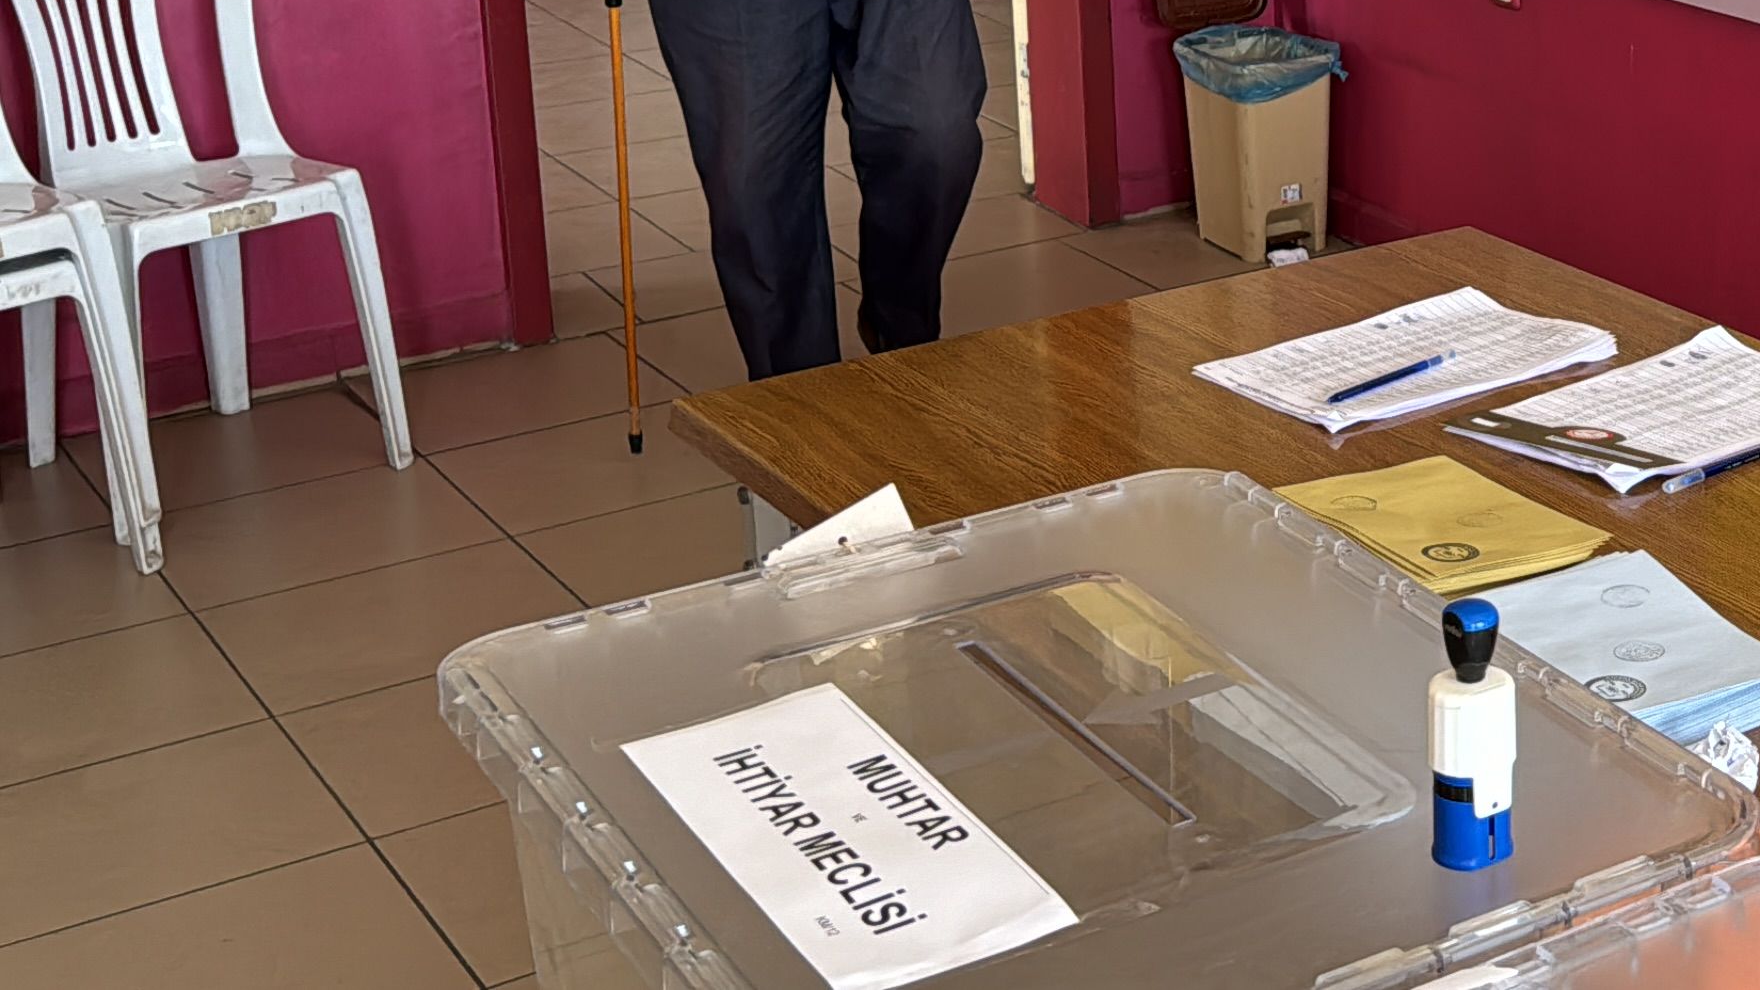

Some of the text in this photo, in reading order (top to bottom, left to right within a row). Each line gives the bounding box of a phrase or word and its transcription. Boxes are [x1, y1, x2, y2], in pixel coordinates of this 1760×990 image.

[712, 745, 928, 935] İHTİYAR MECLİSİ
[846, 754, 970, 850] MUHTAR
